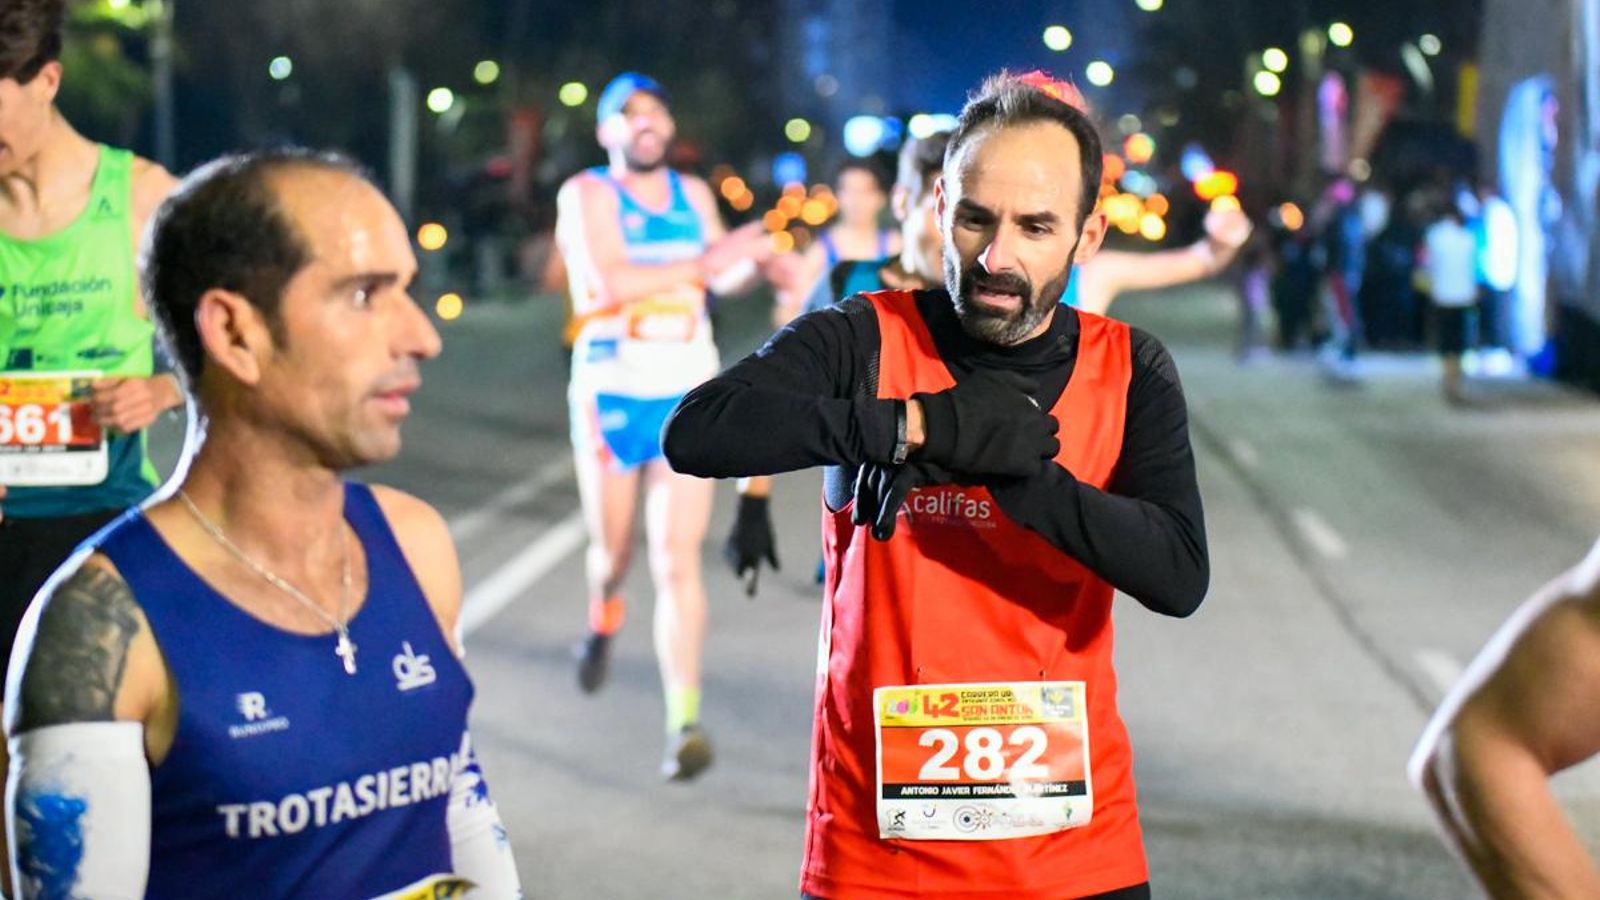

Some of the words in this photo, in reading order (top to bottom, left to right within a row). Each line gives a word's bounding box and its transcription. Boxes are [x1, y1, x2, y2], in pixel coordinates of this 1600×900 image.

[12, 277, 112, 298] Fundación
[914, 491, 991, 519] califas
[923, 692, 960, 718] 42
[961, 705, 987, 717] SAN
[918, 726, 1050, 781] 282
[901, 786, 939, 795] ANTONIO
[941, 786, 970, 795] JAVIER
[973, 784, 1014, 795] FERNÁND
